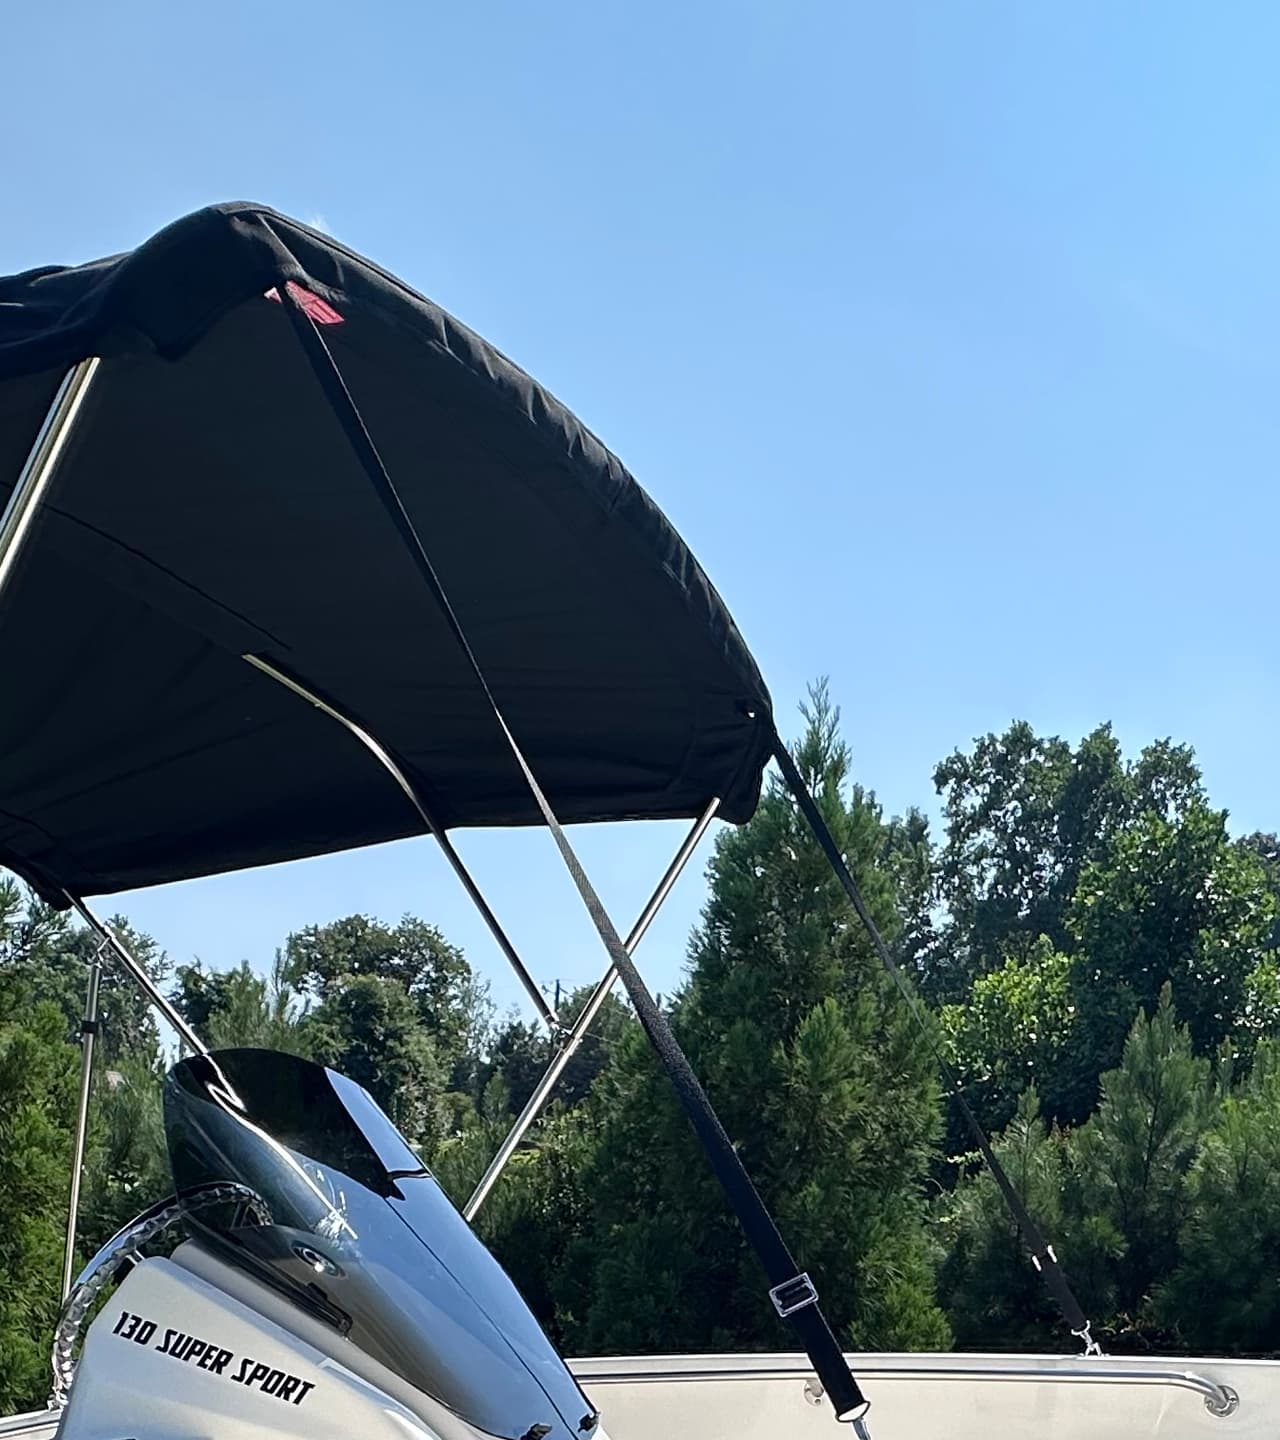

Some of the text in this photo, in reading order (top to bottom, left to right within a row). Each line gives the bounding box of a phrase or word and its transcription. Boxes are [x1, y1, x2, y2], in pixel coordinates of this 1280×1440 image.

[112, 1311, 315, 1405] 130 SUPER SPORT
